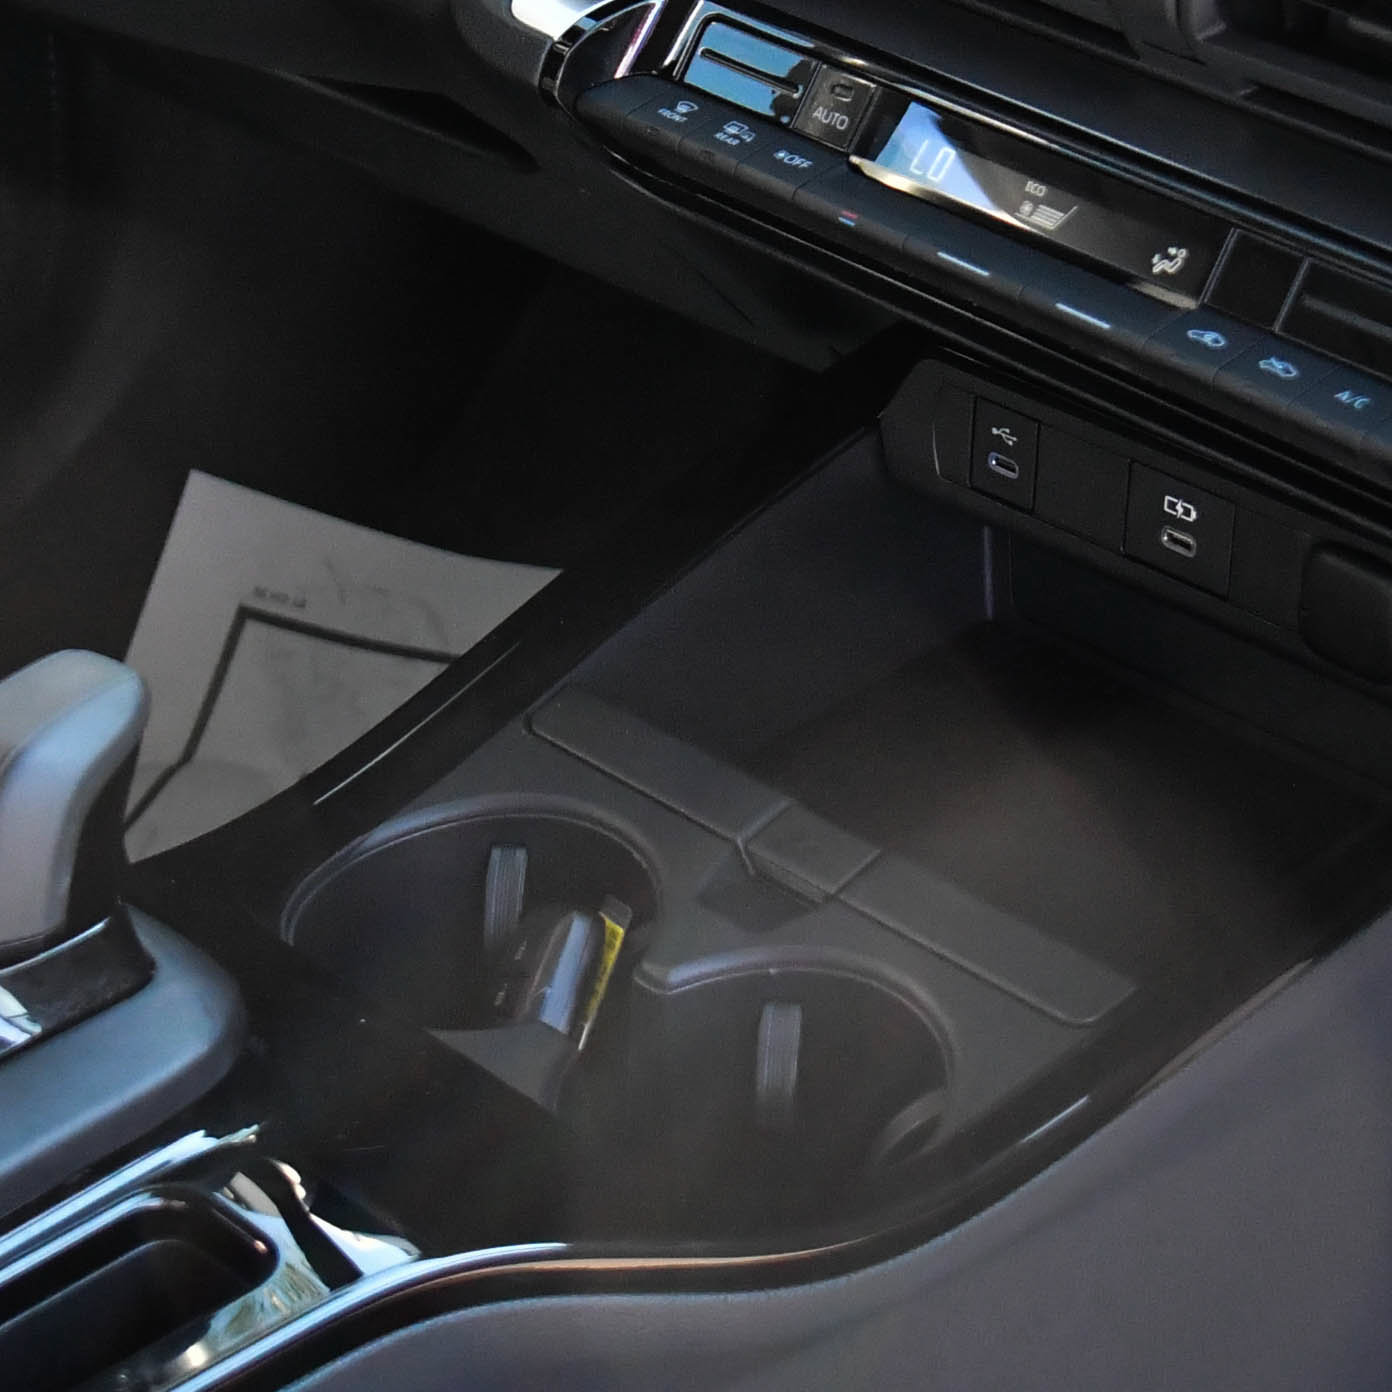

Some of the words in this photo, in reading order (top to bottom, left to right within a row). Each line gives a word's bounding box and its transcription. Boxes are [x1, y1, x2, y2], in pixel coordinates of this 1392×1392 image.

[658, 107, 689, 123] FRONT
[811, 106, 850, 131] AUTO
[714, 132, 741, 146] REAR
[782, 154, 814, 169] OFF
[1024, 180, 1049, 198] ECO
[1333, 390, 1372, 410] A/C
